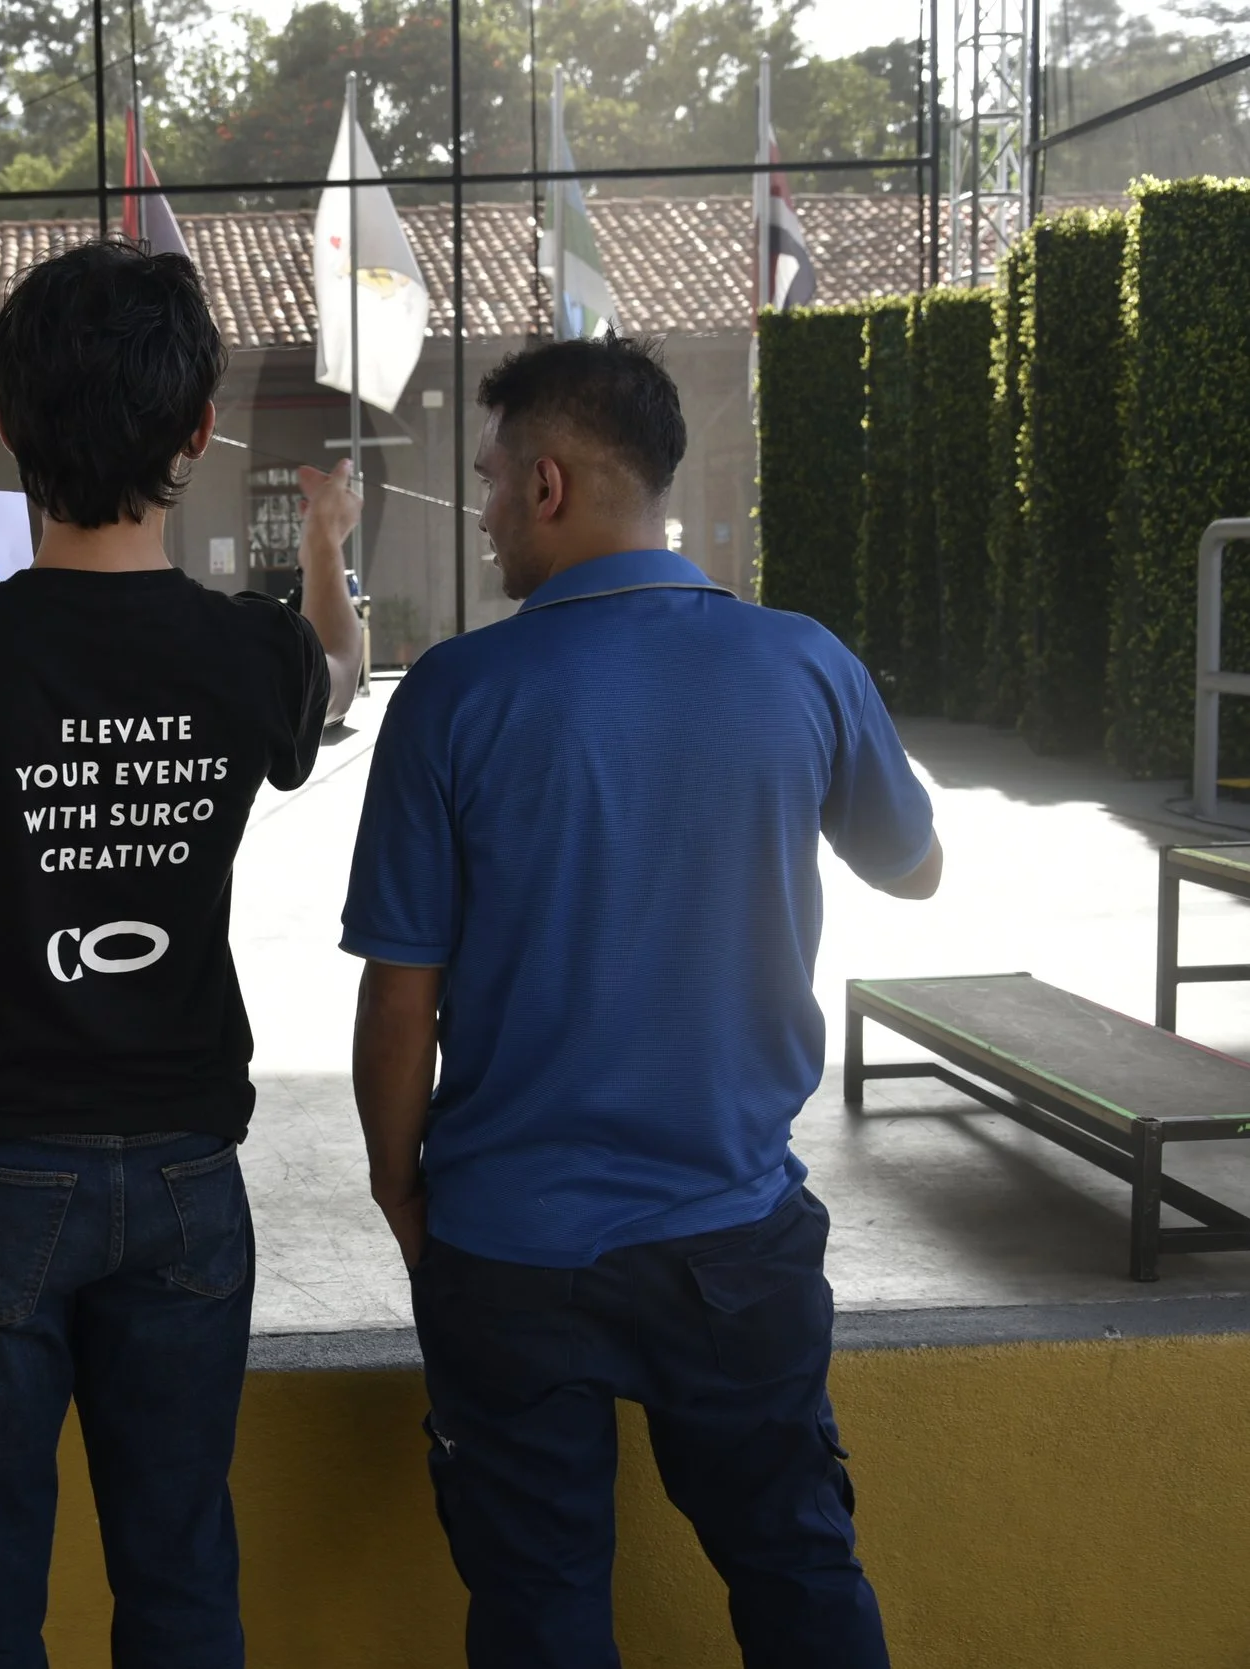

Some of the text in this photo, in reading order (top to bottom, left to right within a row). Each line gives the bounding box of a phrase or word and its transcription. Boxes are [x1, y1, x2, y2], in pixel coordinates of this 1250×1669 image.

[61, 715, 192, 744] ELEVATE
[15, 757, 229, 791] YOUR EVENTS
[23, 798, 214, 834] WITH SURCO
[40, 841, 190, 873] CREATIVO
[47, 920, 170, 983] CO
